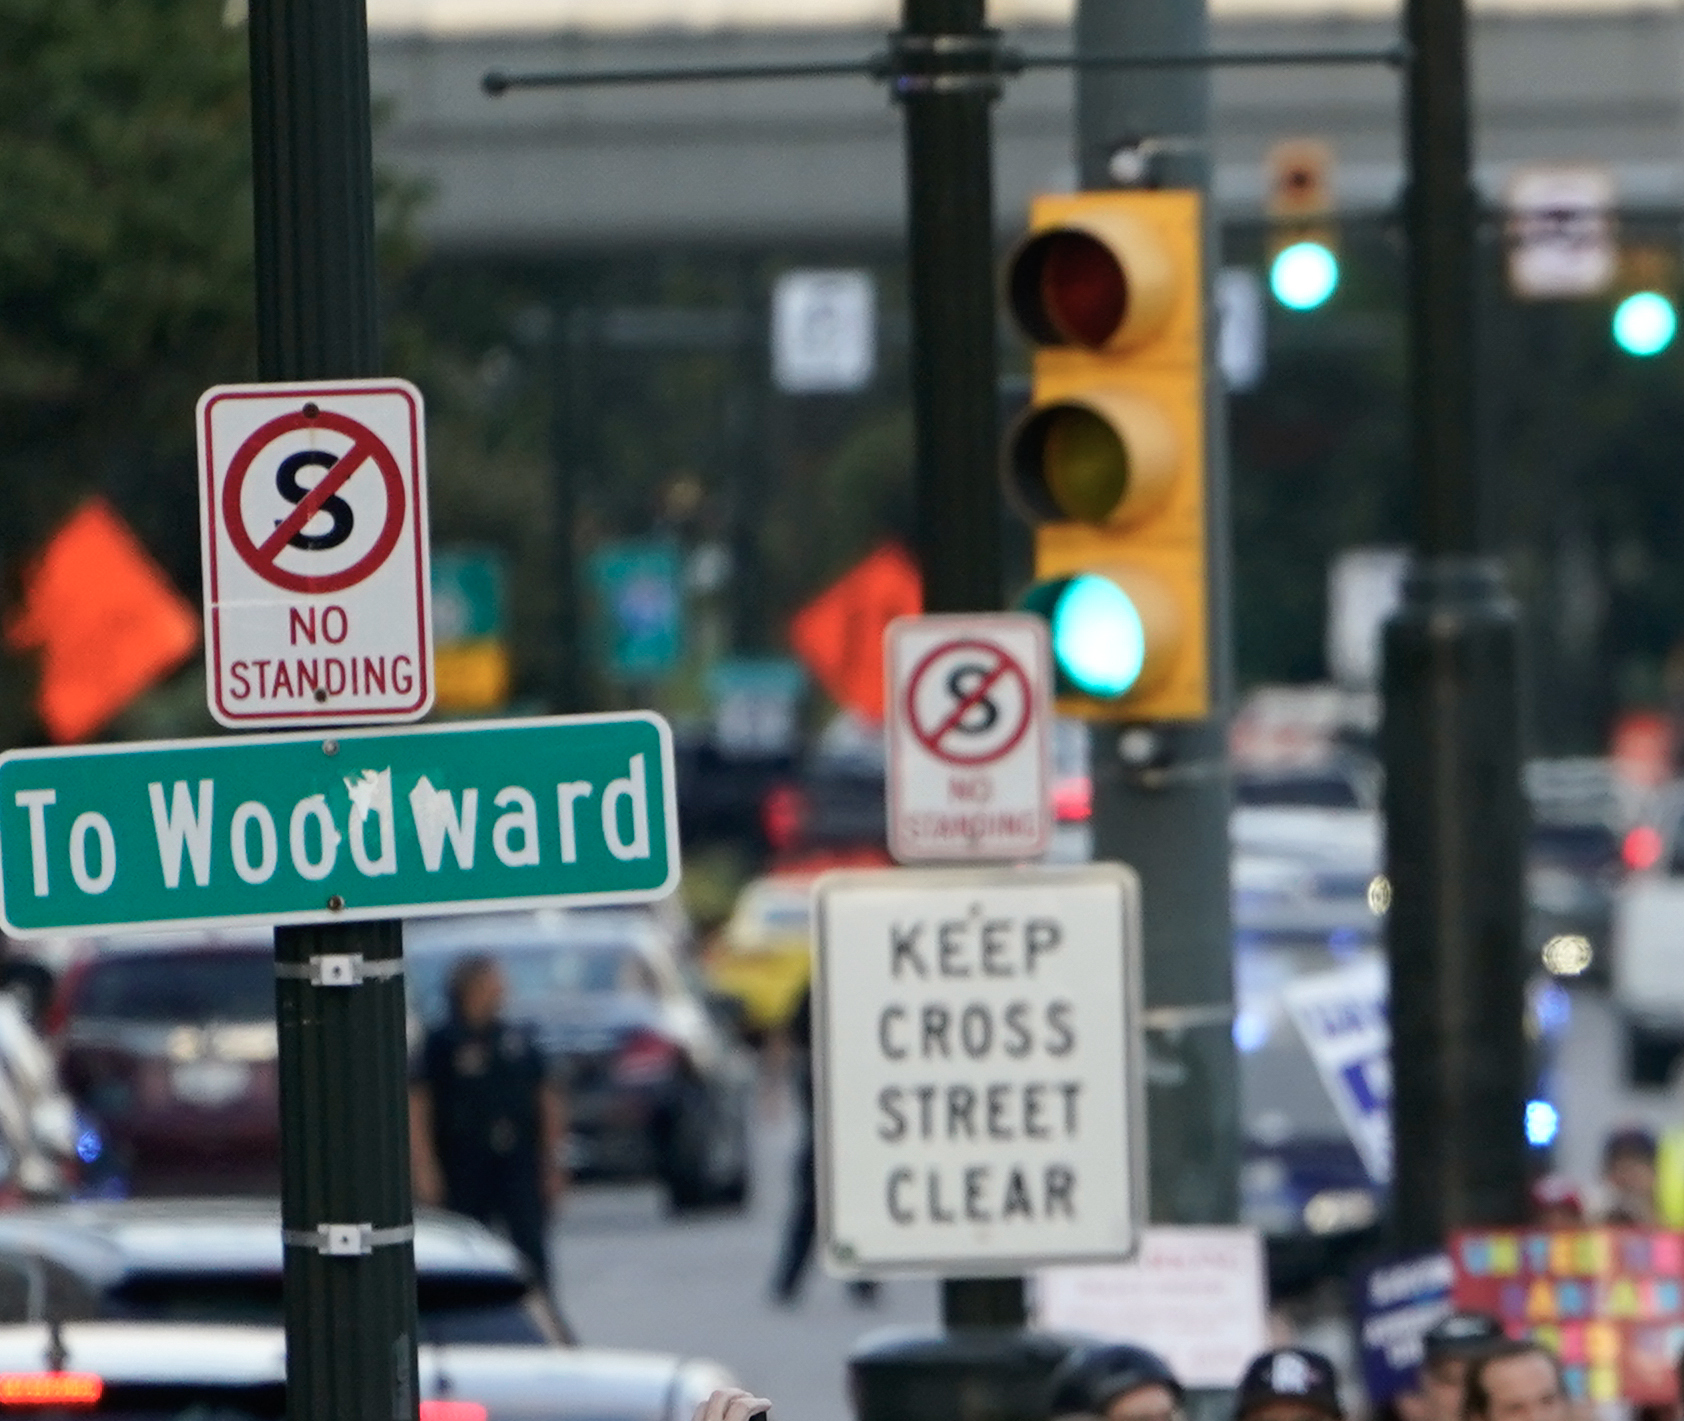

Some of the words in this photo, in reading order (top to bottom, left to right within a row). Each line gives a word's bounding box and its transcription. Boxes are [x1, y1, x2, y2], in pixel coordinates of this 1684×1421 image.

[289, 604, 349, 646] NO
[229, 655, 414, 701] STANDING
[947, 774, 993, 803] NO
[15, 788, 117, 897] To
[148, 752, 651, 890] Woodward
[906, 809, 1037, 842] STANDING
[888, 918, 1062, 980] KEEP
[877, 1001, 1077, 1061] CROSS
[877, 1081, 1083, 1143] STREET
[885, 1164, 1079, 1226] CLEAR
